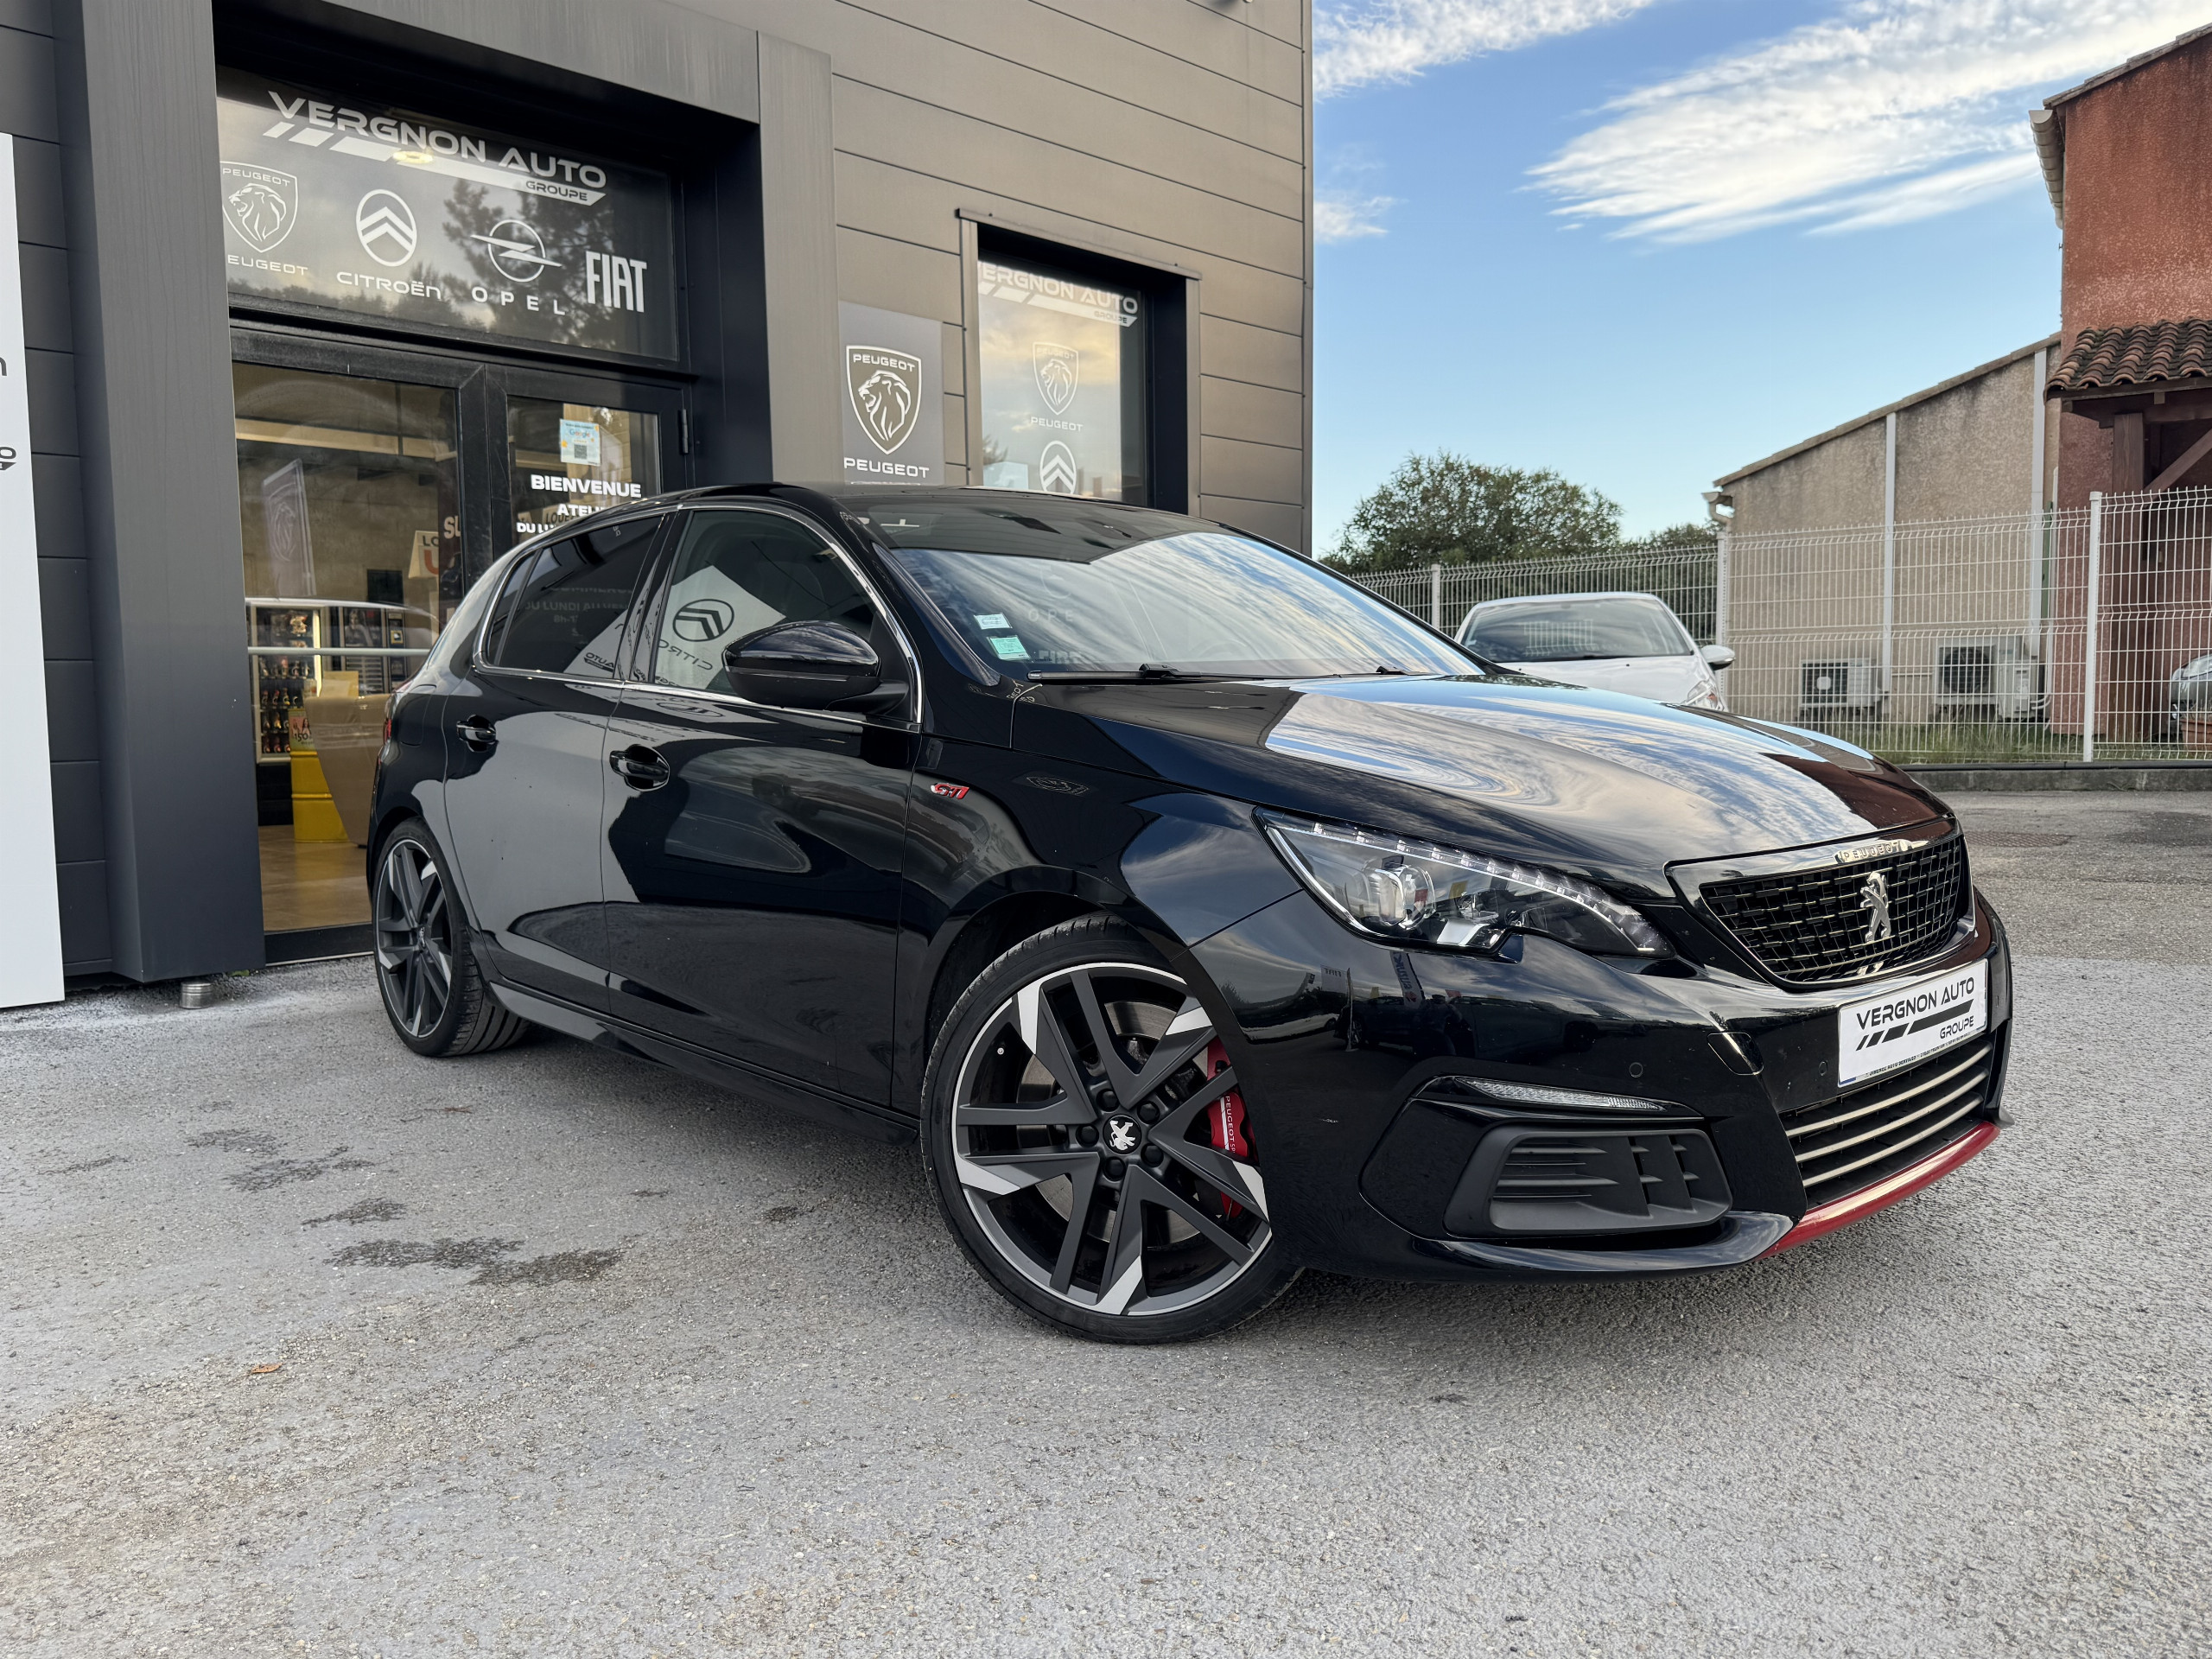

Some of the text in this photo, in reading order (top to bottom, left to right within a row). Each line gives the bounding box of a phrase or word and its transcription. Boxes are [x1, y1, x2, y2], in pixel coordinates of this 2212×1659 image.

[268, 91, 607, 188] VERGNON AUTO
[222, 168, 290, 187] PEUGEOT
[525, 180, 588, 202] GROUPE
[227, 254, 308, 276] EUGEOT
[585, 251, 647, 313] FIAT
[978, 262, 1138, 315] ERGNON AUTO
[472, 286, 566, 316] OPEL
[1094, 310, 1128, 324] GROUPE
[852, 353, 915, 372] PEUGEOT
[1031, 416, 1084, 431] PEUGEOT
[843, 456, 929, 478] PEUGEOT
[531, 474, 642, 499] BIENVENUE
[517, 522, 536, 534] DU
[1843, 842, 1899, 859] PEUGEOT
[1856, 977, 1974, 1030] VERGNON AUTO
[1940, 1015, 1974, 1039] GROUPE
[1225, 1096, 1235, 1142] PEUGEOT
